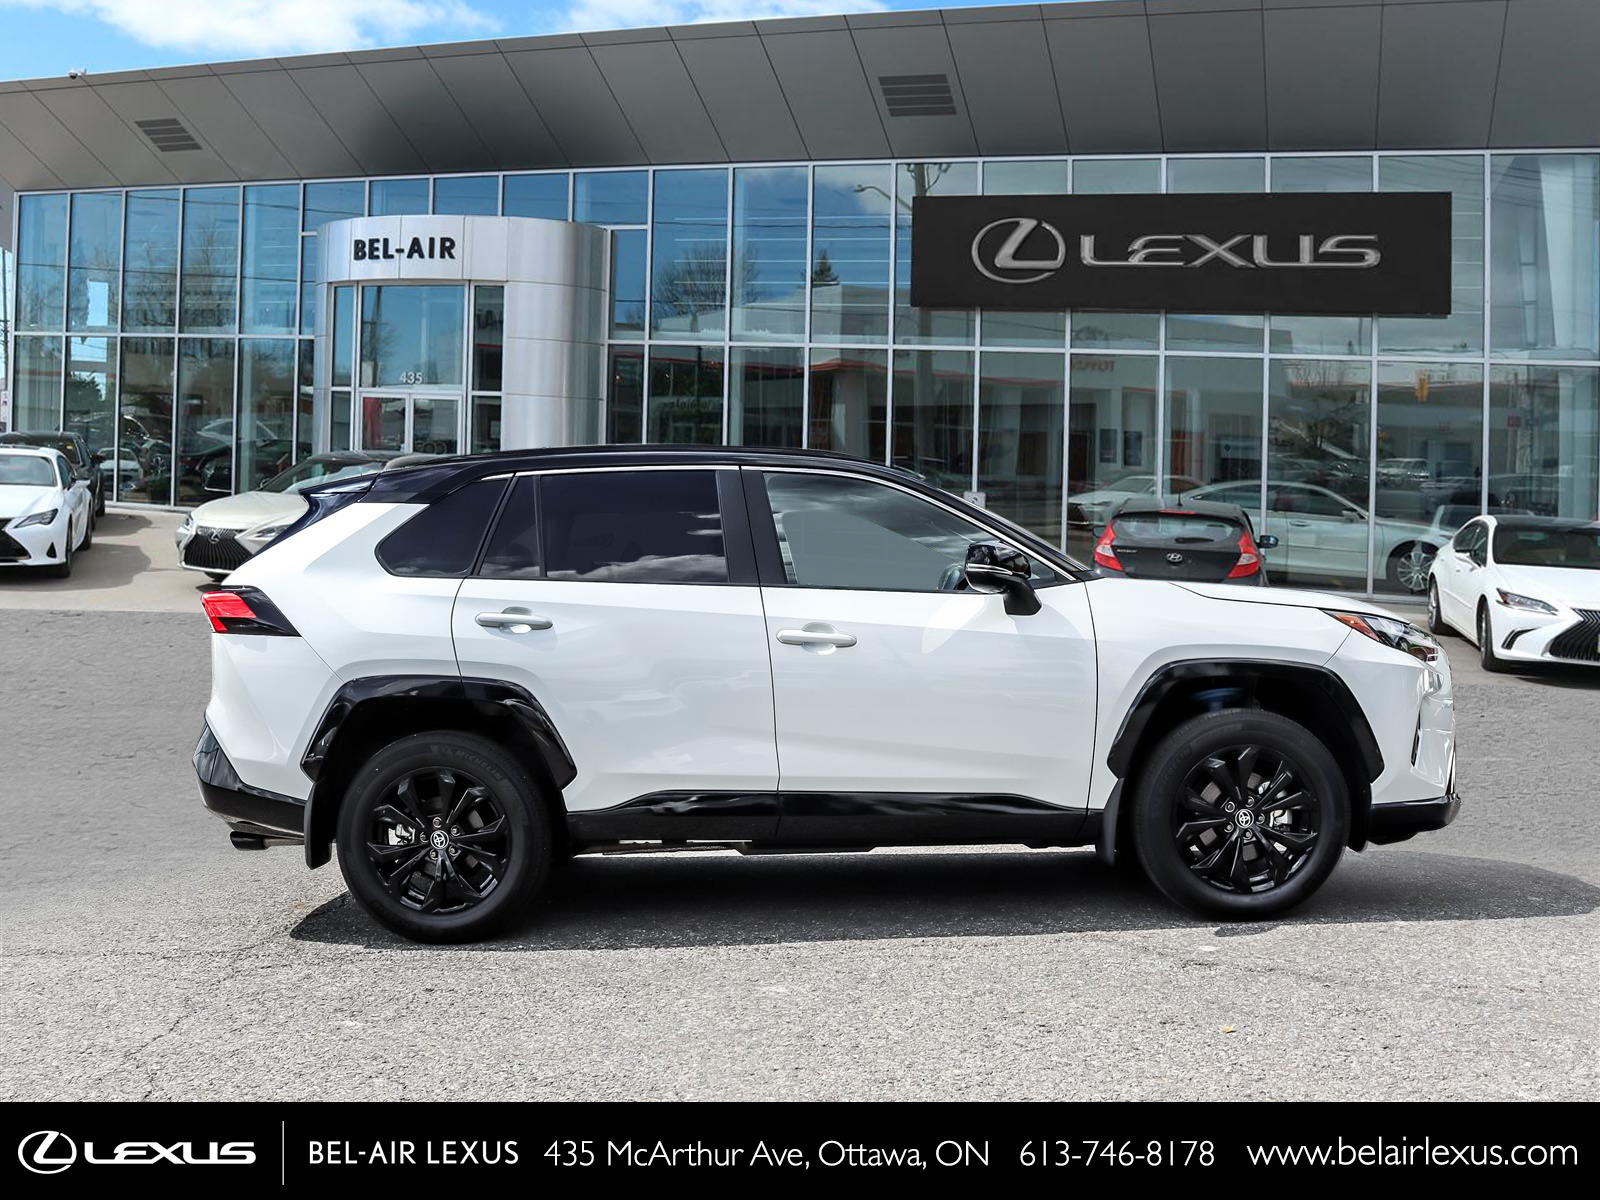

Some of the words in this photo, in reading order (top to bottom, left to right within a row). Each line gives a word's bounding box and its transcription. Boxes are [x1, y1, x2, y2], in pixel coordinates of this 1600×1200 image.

[353, 236, 456, 260] BEL-AIR
[1079, 234, 1382, 268] LEXUS
[400, 371, 423, 385] 435
